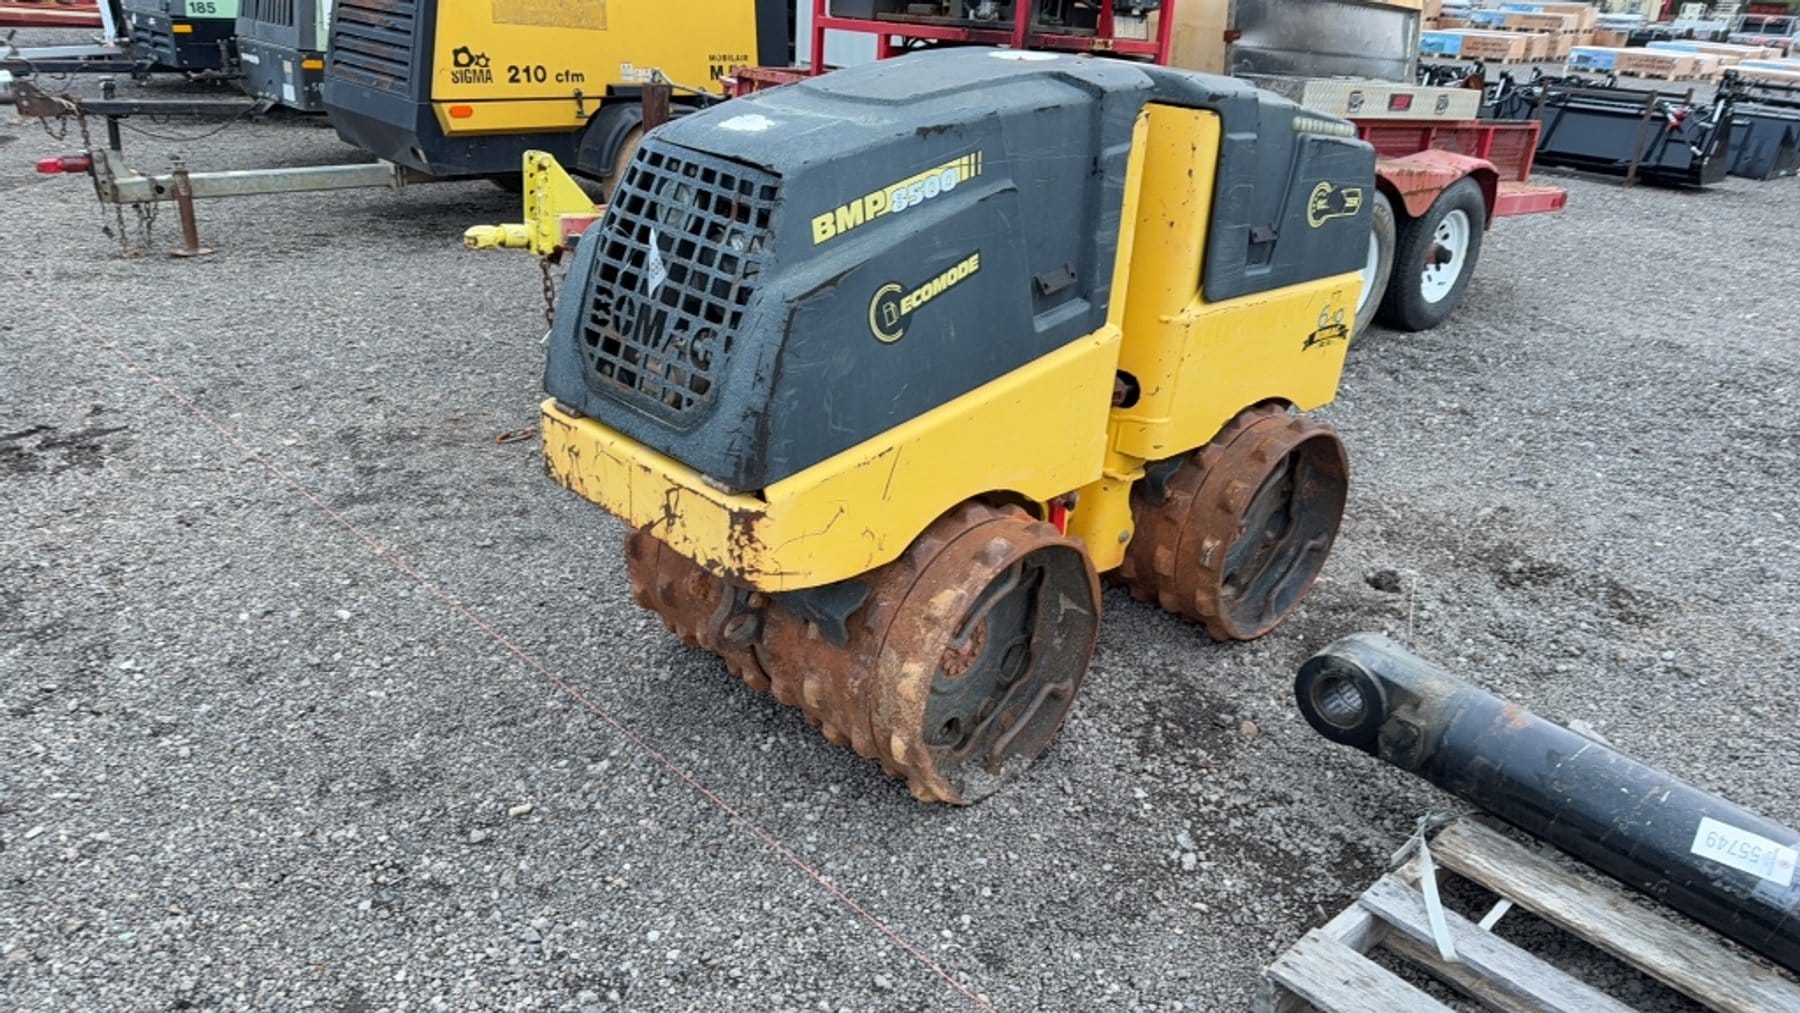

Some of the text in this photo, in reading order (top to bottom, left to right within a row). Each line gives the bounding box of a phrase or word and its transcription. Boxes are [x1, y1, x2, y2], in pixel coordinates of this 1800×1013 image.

[189, 2, 216, 14] 185
[708, 54, 748, 62] MOBILAIR
[451, 69, 494, 84] SIGMA
[507, 65, 585, 83] 210 cfm
[811, 167, 958, 245] BMP 8500
[900, 253, 980, 316] ECOMODE
[590, 284, 718, 372] BOMAG
[1706, 832, 1762, 862] 55749
